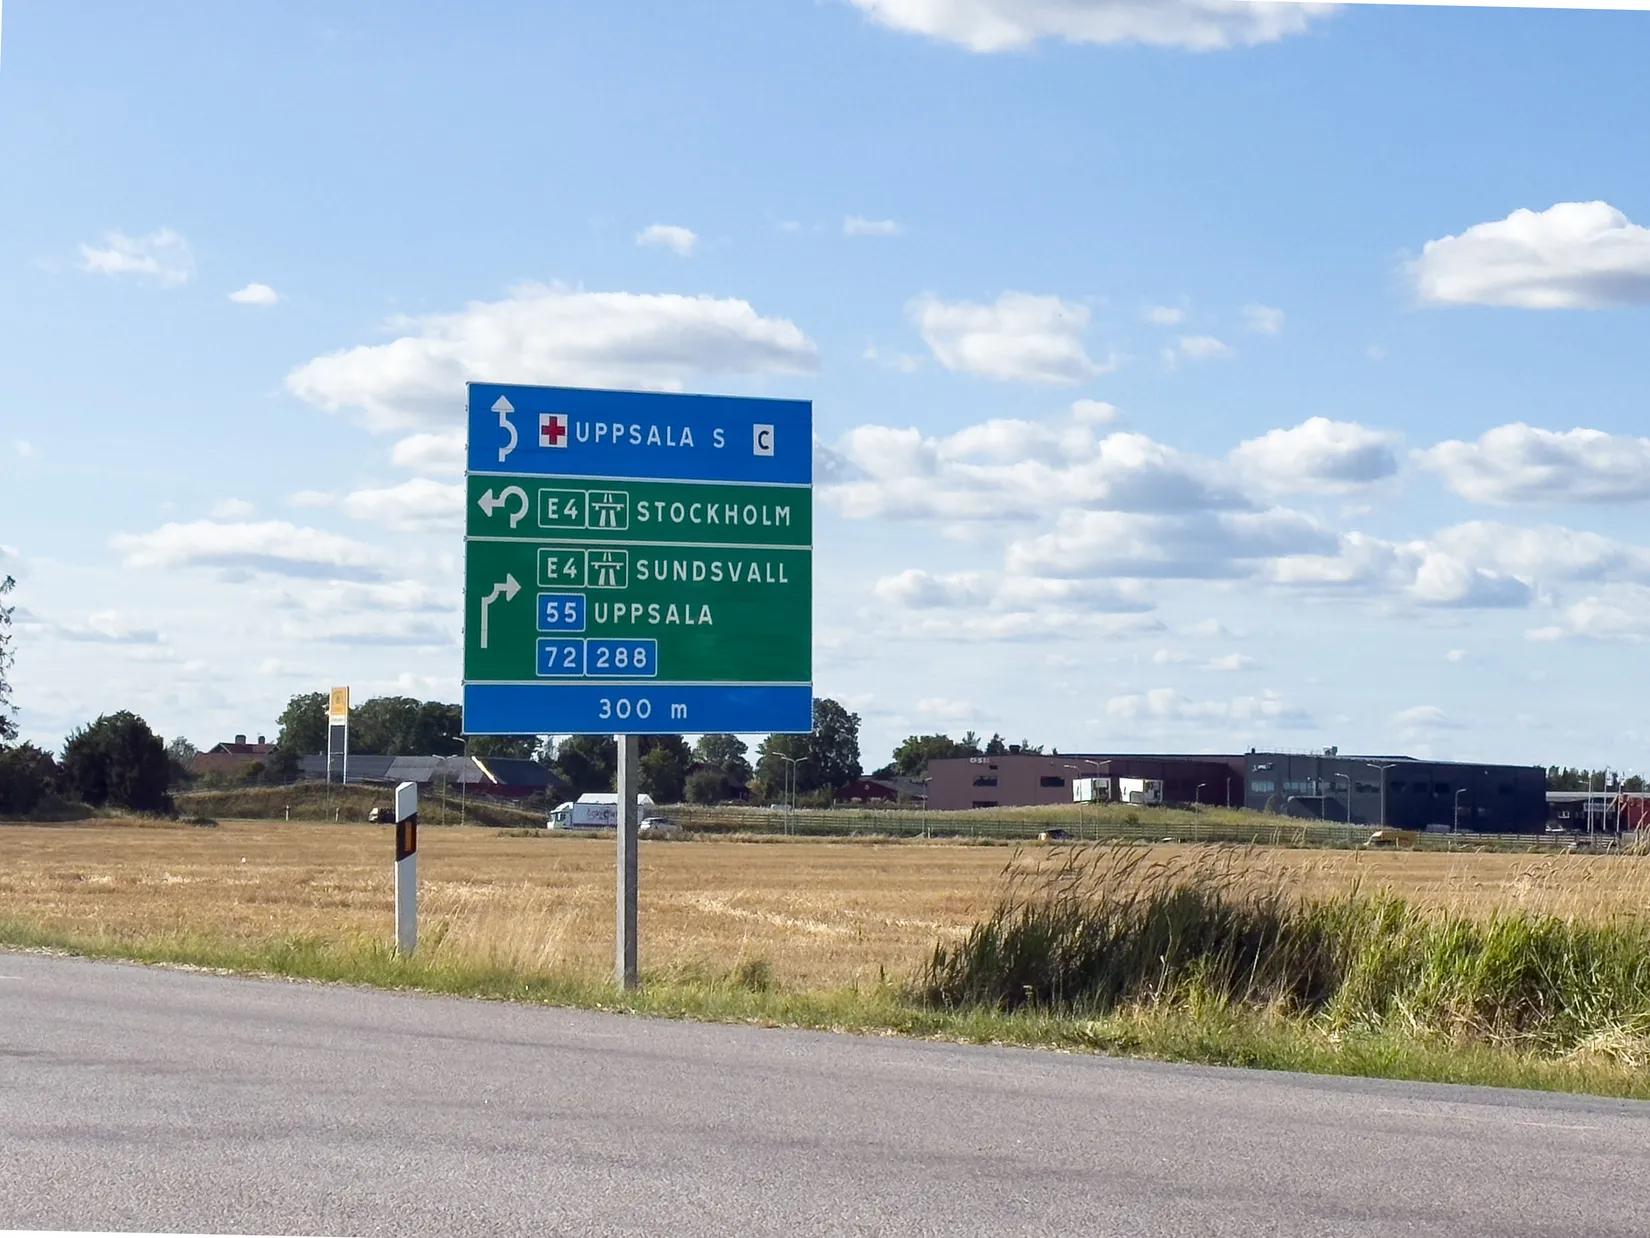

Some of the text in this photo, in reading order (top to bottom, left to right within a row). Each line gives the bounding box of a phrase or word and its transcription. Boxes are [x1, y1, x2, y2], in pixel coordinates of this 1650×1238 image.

[576, 421, 770, 450] UPPSALA S C
[548, 497, 790, 526] E4 STOCKHOLM
[547, 557, 788, 583] E4 SUNDSVALL
[546, 601, 713, 625] 55 UPPSALA
[544, 646, 647, 669] 72 288
[598, 698, 688, 719] 300 m
